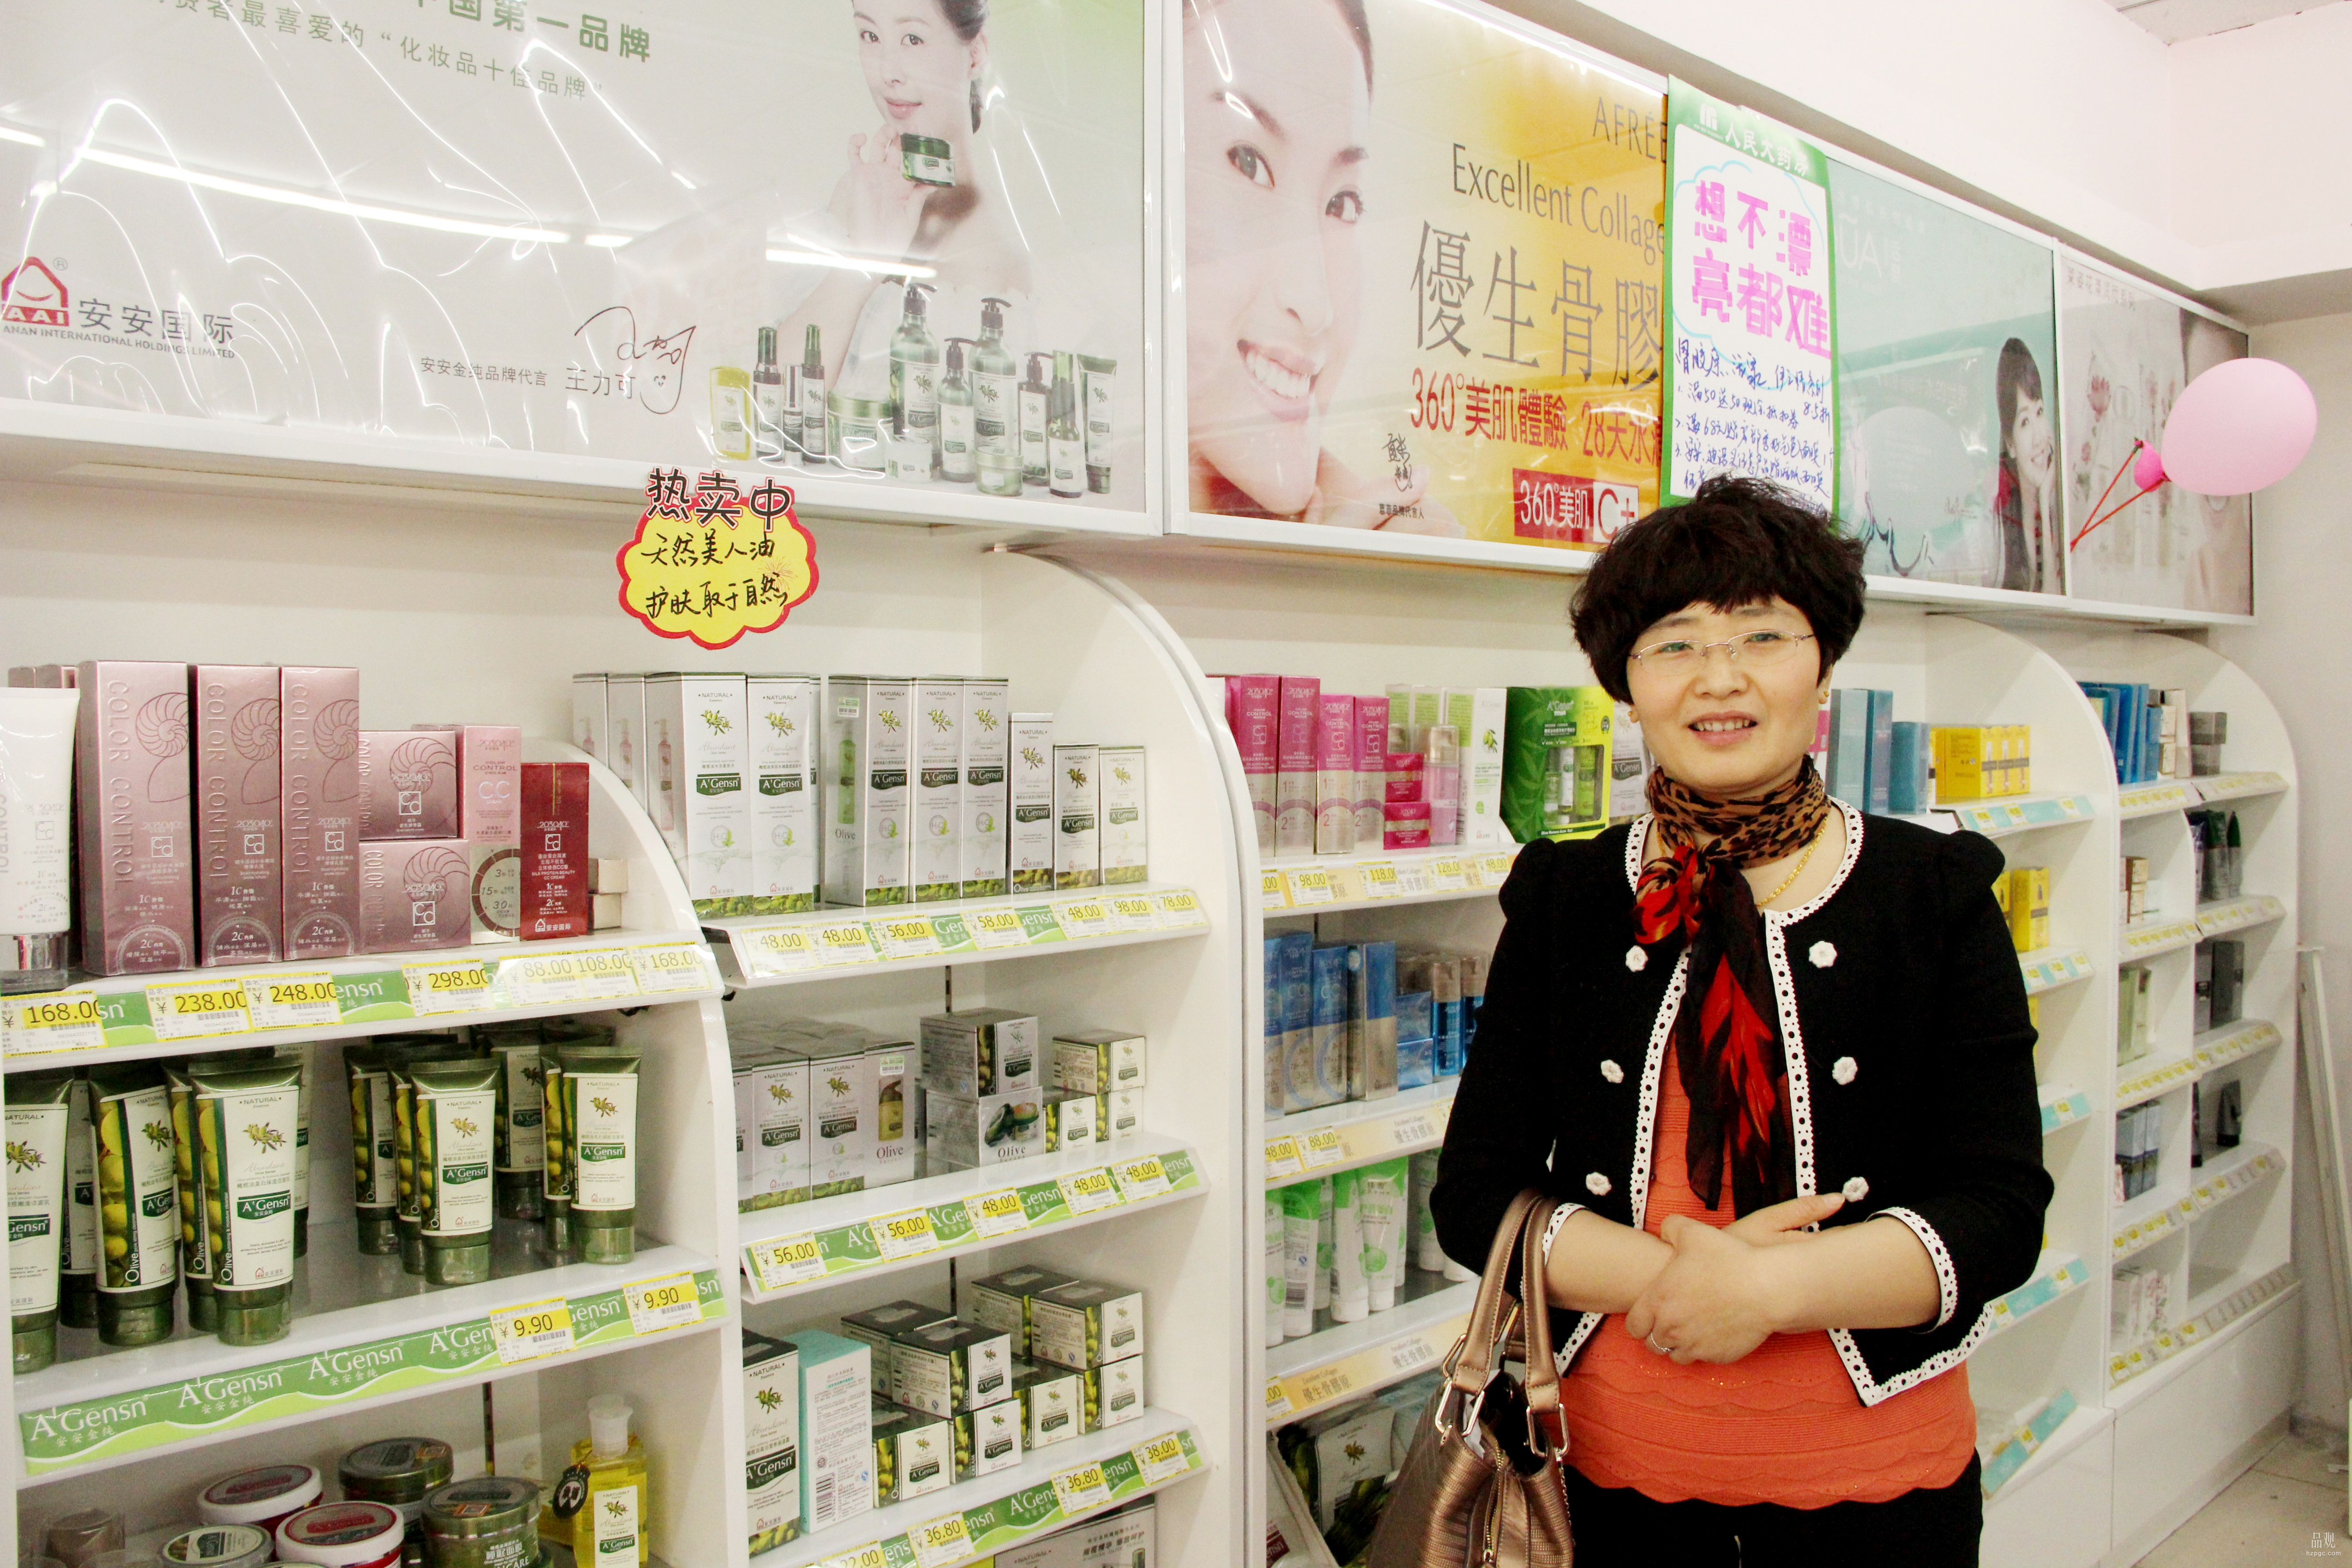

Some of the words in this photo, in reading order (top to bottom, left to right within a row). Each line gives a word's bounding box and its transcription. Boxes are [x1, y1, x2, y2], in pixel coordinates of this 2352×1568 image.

[418, 0, 651, 63] 国第一品牌
[160, 0, 603, 101] 者最喜爱的“化妆品十佳品牌”
[1725, 121, 1809, 177] 人民大药房
[1453, 142, 1573, 226] Excellent
[1695, 180, 1812, 277] 想不漂
[1411, 220, 1663, 392] 優生骨膠
[1692, 247, 1832, 360] 亮都难
[78, 299, 234, 344] 安安国际
[4, 325, 37, 336] ANAN
[41, 329, 132, 347] INTERNATIONAL
[135, 340, 188, 353] HOLDINGS
[192, 347, 234, 358] LIMITED
[421, 356, 548, 387] 安安金纯品牌代言
[647, 467, 792, 531] 热卖中
[1520, 479, 1589, 529] 360°美肌
[108, 680, 131, 763] COLOR
[206, 682, 227, 763] COLOR
[291, 683, 309, 762] COLOR
[478, 780, 511, 799] CC
[109, 776, 134, 884] CONTROL
[208, 776, 228, 877] CONTROL
[291, 774, 310, 873] CONTROL
[835, 828, 856, 841] Olive
[364, 851, 385, 889] COLOR
[1299, 872, 1326, 886] 98.00
[1068, 905, 1101, 920] 48.00
[1114, 900, 1147, 913] 98.00
[1160, 894, 1191, 908] 78.00
[886, 922, 926, 938] 56.00
[977, 913, 1014, 929] 58.00
[760, 932, 802, 950] 48.00
[823, 928, 862, 945] 48.00
[523, 959, 573, 978] 88.00
[175, 990, 248, 1014] 238.00
[270, 981, 337, 1003] 248.00
[244, 1097, 278, 1105] NATURAL
[584, 1147, 624, 1156] A'Gensn
[998, 1145, 1026, 1158] Olive
[1308, 1132, 1335, 1148] 88.00
[877, 1145, 903, 1159] Olive
[446, 1167, 487, 1178] A'Gensn
[1125, 1161, 1157, 1178] 48.00
[1074, 1174, 1106, 1191] 48.00
[242, 1198, 289, 1213] A'Gensn
[982, 1194, 1017, 1212] 48.00
[1018, 1186, 1062, 1205] Gensn
[887, 1216, 926, 1238] 56.00
[193, 1241, 205, 1270] Olive
[773, 1242, 815, 1265] 56.00
[125, 1252, 140, 1283] Olive
[220, 1252, 233, 1281] Olive
[644, 1288, 679, 1309] 9.90
[514, 1314, 553, 1337] 9.90
[428, 1325, 495, 1354] A'Gen
[309, 1345, 403, 1381] A'Gensn
[753, 1363, 782, 1378] NATURAL
[178, 1368, 283, 1409] A'Gensn
[30, 1399, 148, 1441] A'Gensn
[1145, 1439, 1176, 1457] 38.00
[1066, 1469, 1099, 1490] 36.80
[924, 1520, 961, 1544] 36.80
